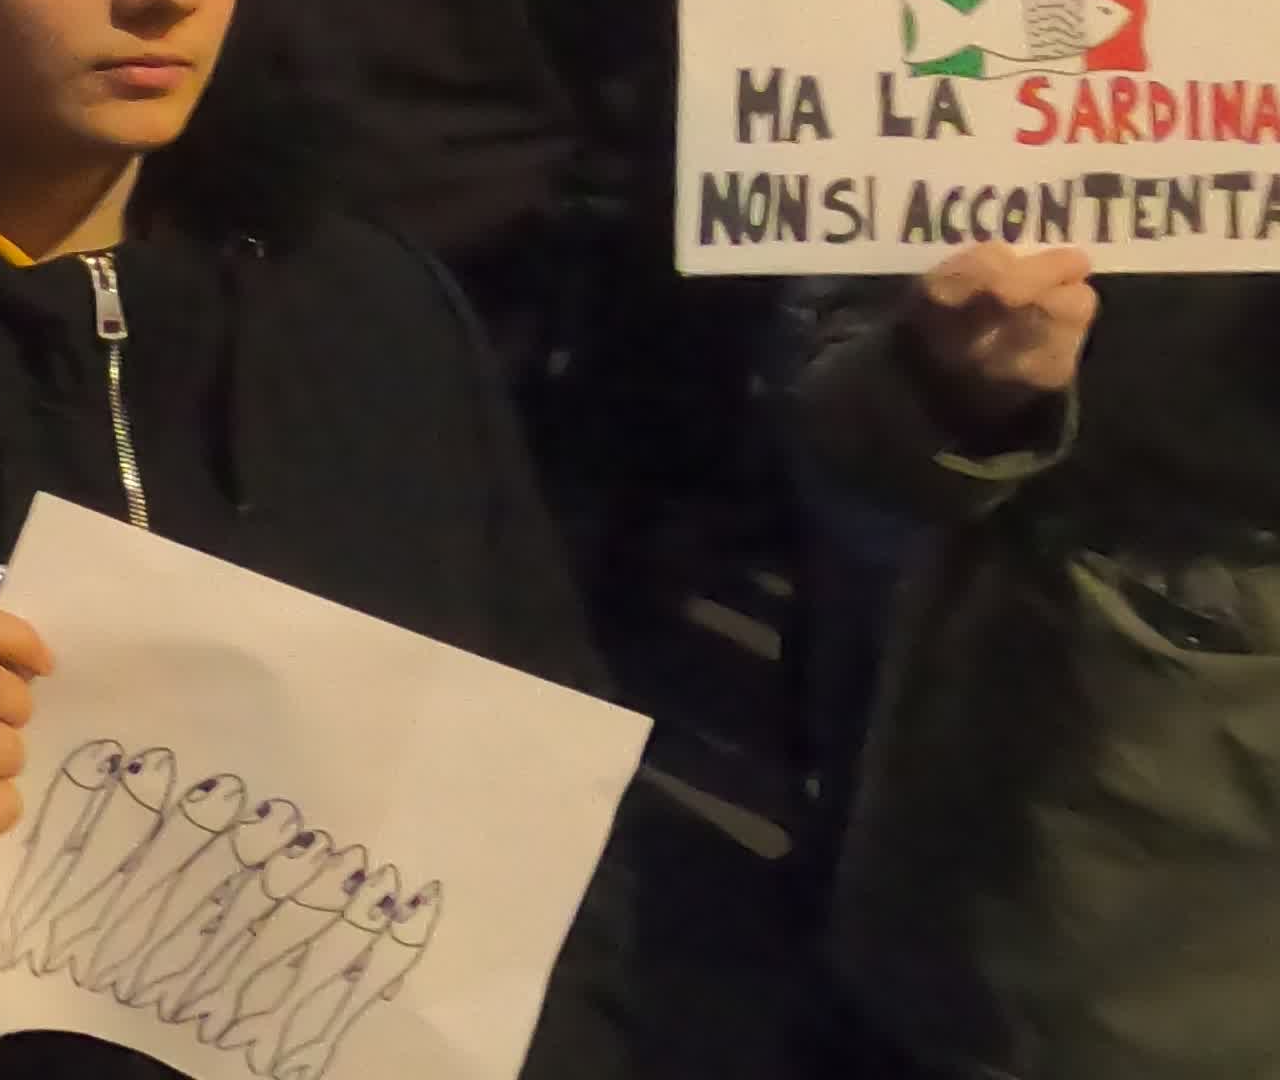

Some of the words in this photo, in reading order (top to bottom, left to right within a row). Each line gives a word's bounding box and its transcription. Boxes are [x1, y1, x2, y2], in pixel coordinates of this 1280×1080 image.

[737, 67, 831, 143] MA
[877, 72, 971, 139] LA
[1015, 77, 1280, 145] SARDINA
[700, 172, 808, 246] NON
[824, 174, 876, 244] SI
